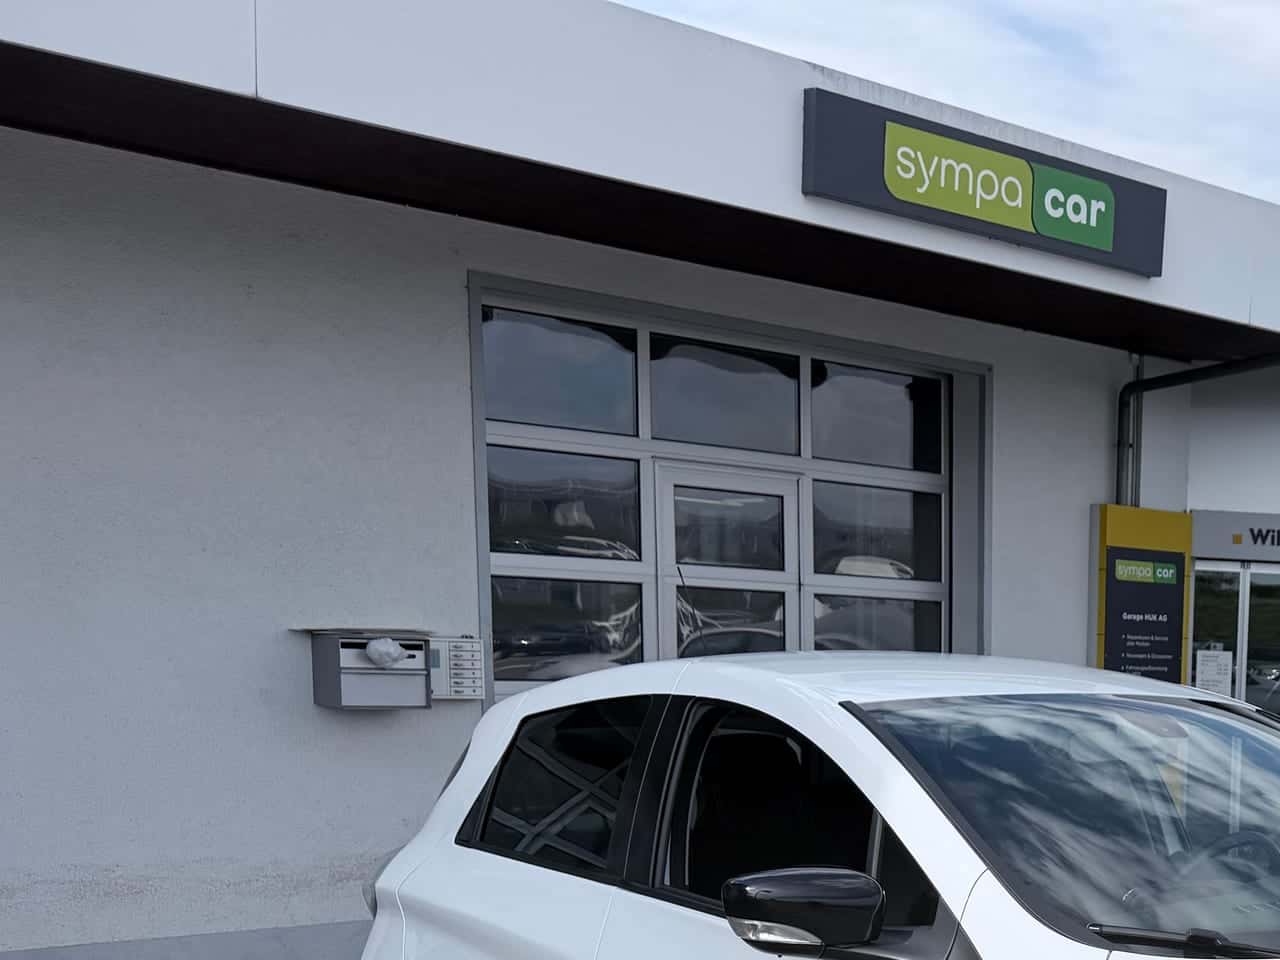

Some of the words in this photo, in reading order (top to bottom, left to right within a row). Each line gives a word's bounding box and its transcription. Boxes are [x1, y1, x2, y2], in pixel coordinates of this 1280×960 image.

[896, 145, 1023, 208] sympa
[1044, 187, 1106, 228] car
[1117, 564, 1152, 579] sympa
[1156, 567, 1175, 578] car
[1122, 611, 1143, 622] Garage
[1158, 614, 1168, 622] AG
